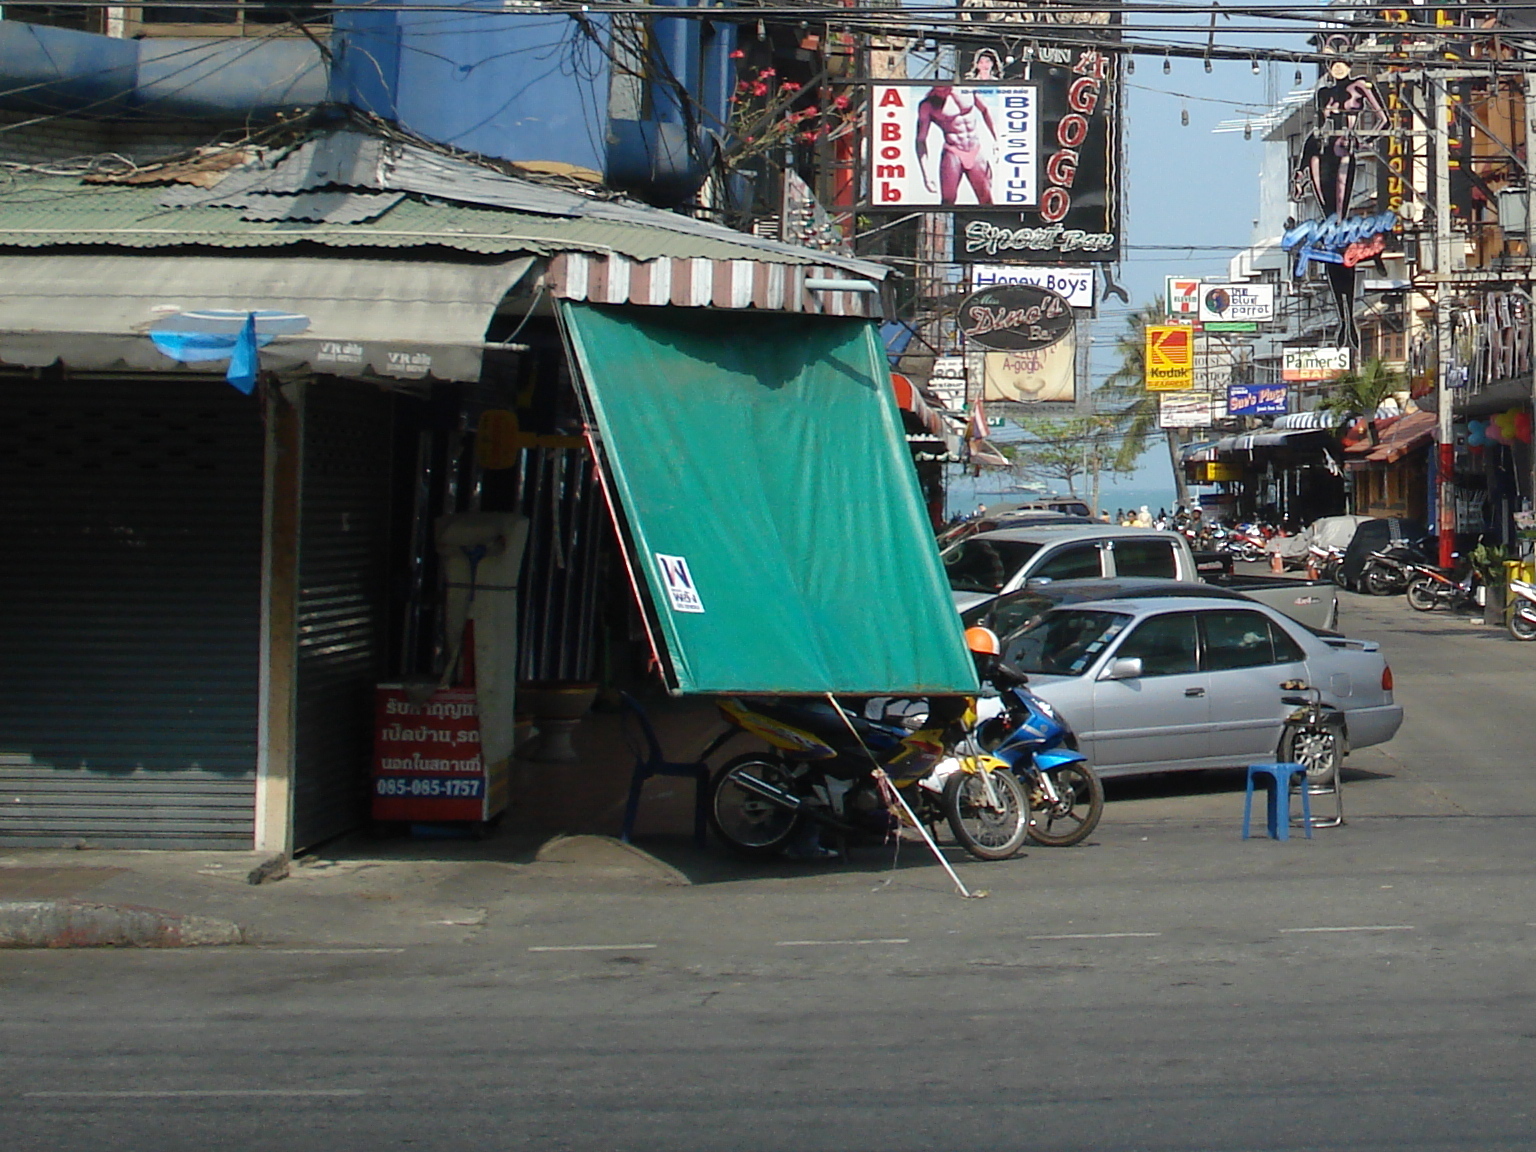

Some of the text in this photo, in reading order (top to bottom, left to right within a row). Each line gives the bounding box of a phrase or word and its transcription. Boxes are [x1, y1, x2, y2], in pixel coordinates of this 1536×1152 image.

[1048, 274, 1087, 300] Boys
[1175, 282, 1197, 312] 7
[1231, 295, 1258, 305] blue
[965, 295, 1065, 337] Dino's
[1231, 305, 1270, 318] parrot
[1151, 367, 1188, 378] Kodak
